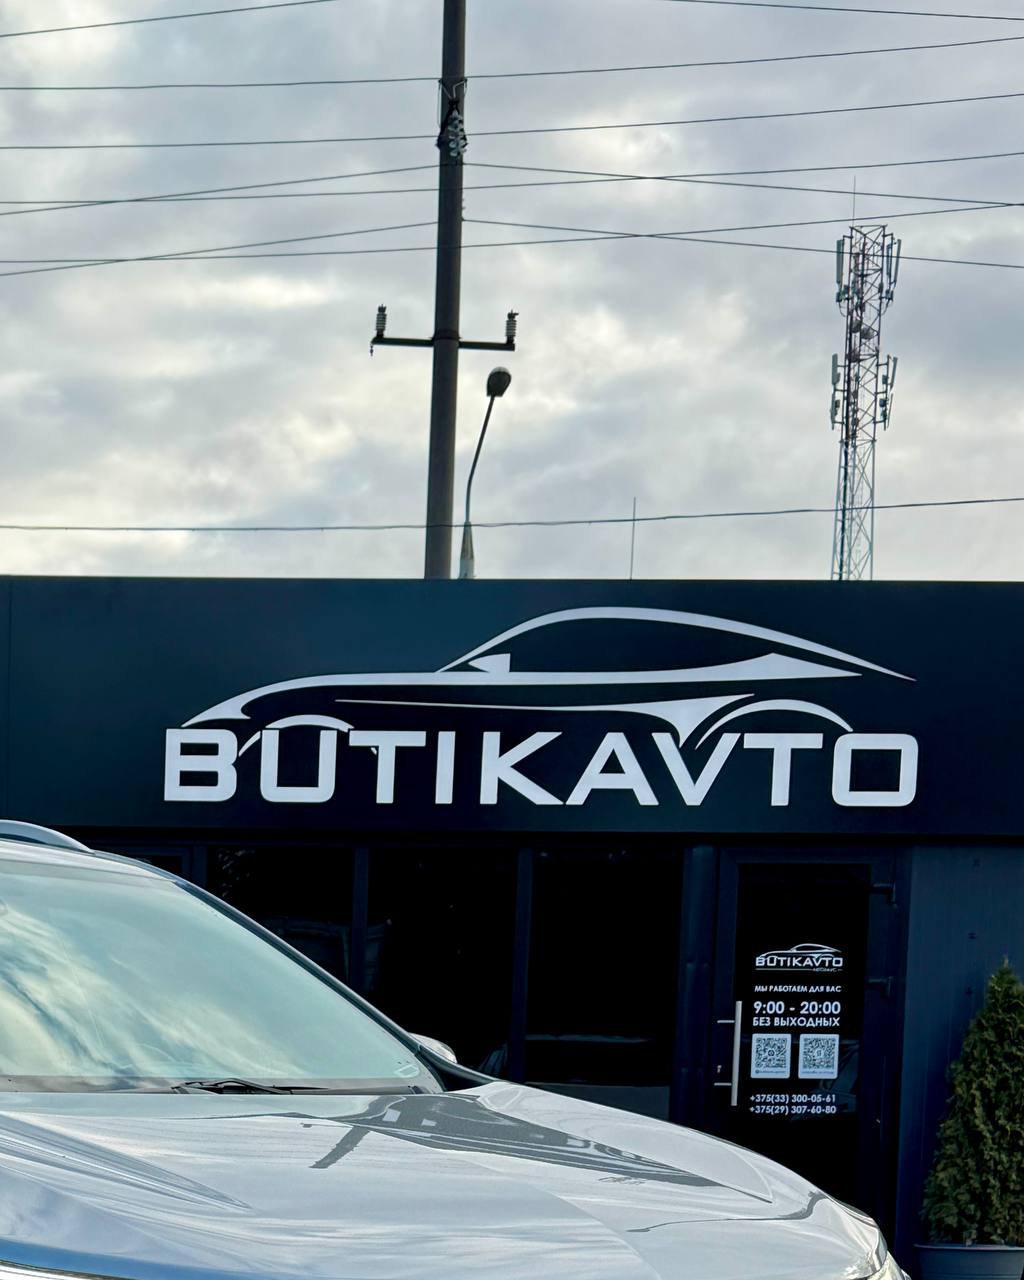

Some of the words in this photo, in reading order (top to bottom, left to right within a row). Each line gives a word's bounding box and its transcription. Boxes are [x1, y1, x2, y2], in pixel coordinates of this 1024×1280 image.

[163, 728, 919, 807] BUTIKAVTO
[755, 956, 844, 967] BUTIKAVTO
[754, 985, 768, 993] МЫ
[769, 985, 808, 993] РАБОТАЕМ
[809, 985, 825, 993] ДЛЯ
[826, 985, 842, 993] ВАС
[753, 1001, 785, 1015] 9:00
[799, 1001, 841, 1015] 20:00
[752, 1016, 771, 1027] БЕЗ
[773, 1016, 840, 1028] ВЫХОДНЫХ
[750, 1094, 789, 1104] +375(33)
[791, 1094, 836, 1103] 300-05-61
[749, 1105, 789, 1116] +375(29)
[790, 1105, 837, 1114] 307-60-80
